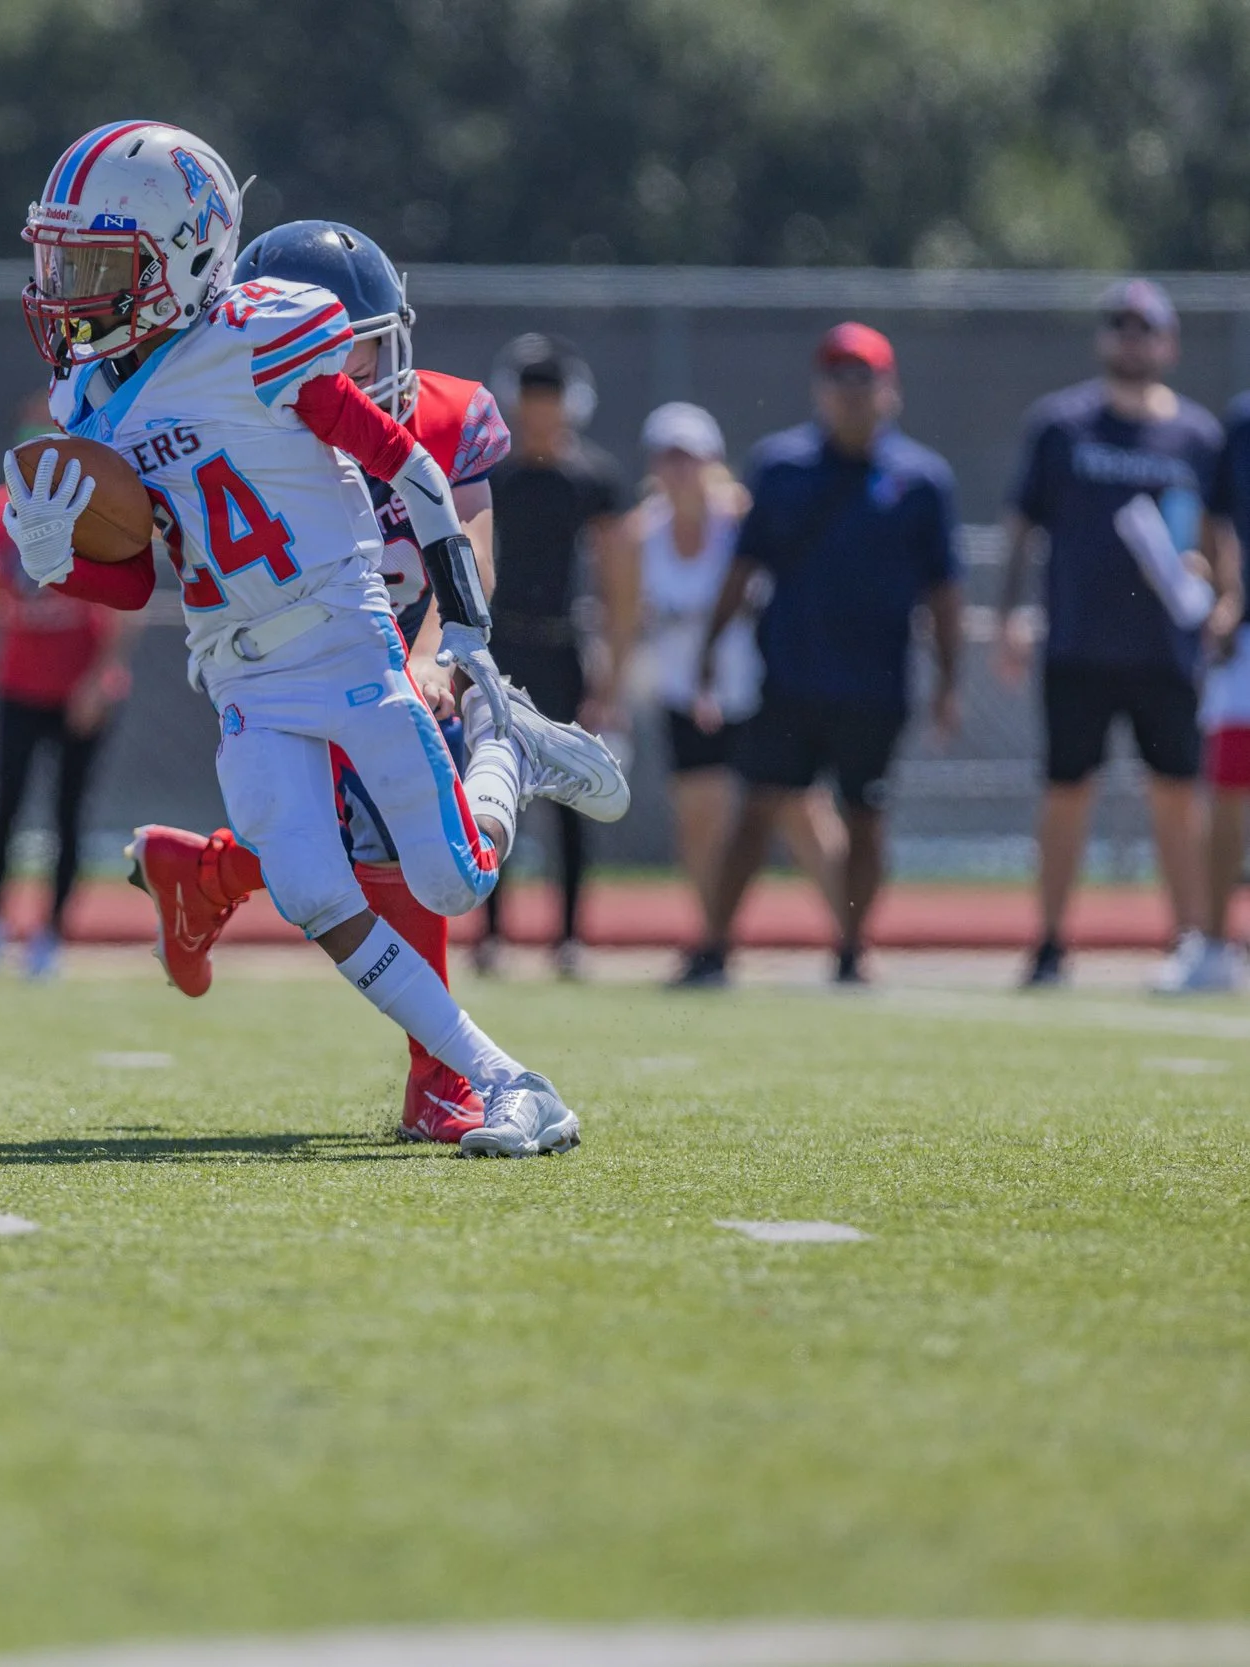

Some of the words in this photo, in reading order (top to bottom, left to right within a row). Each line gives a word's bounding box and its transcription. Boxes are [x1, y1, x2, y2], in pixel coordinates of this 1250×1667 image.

[46, 208, 72, 220] Riddel
[131, 426, 201, 475] ERS
[21, 521, 60, 543] ATTLE
[360, 945, 398, 988] BATTLE
